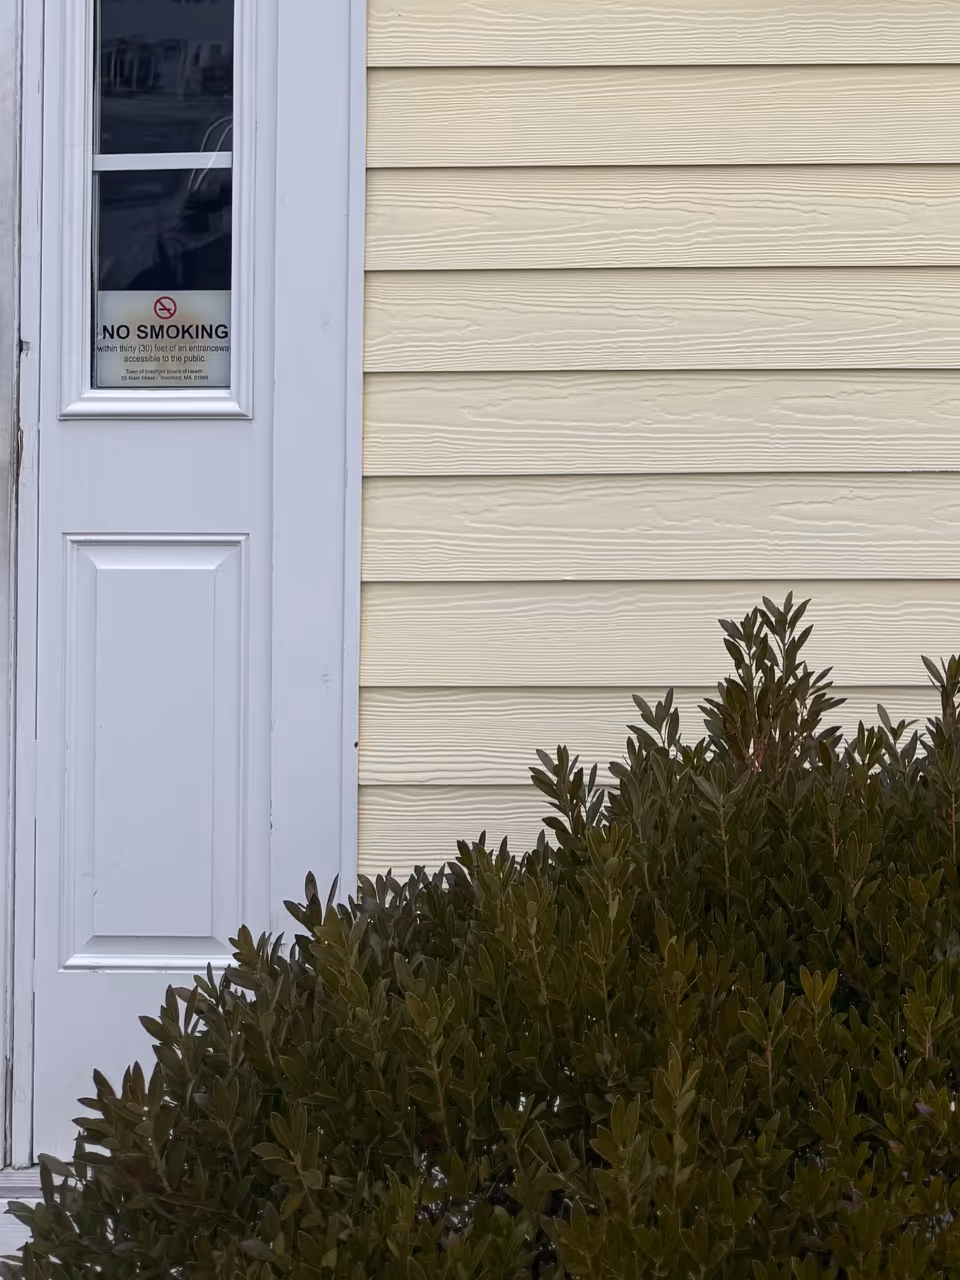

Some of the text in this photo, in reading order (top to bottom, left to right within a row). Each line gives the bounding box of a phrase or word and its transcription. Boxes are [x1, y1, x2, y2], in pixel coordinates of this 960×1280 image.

[103, 324, 229, 340] NO SMOKING
[119, 344, 137, 354] thirty
[138, 344, 153, 353] (30)
[154, 344, 168, 353] feet
[170, 344, 176, 353] of
[178, 345, 187, 353] an
[124, 355, 161, 363] accessible
[162, 355, 170, 363] to
[171, 355, 182, 363] the
